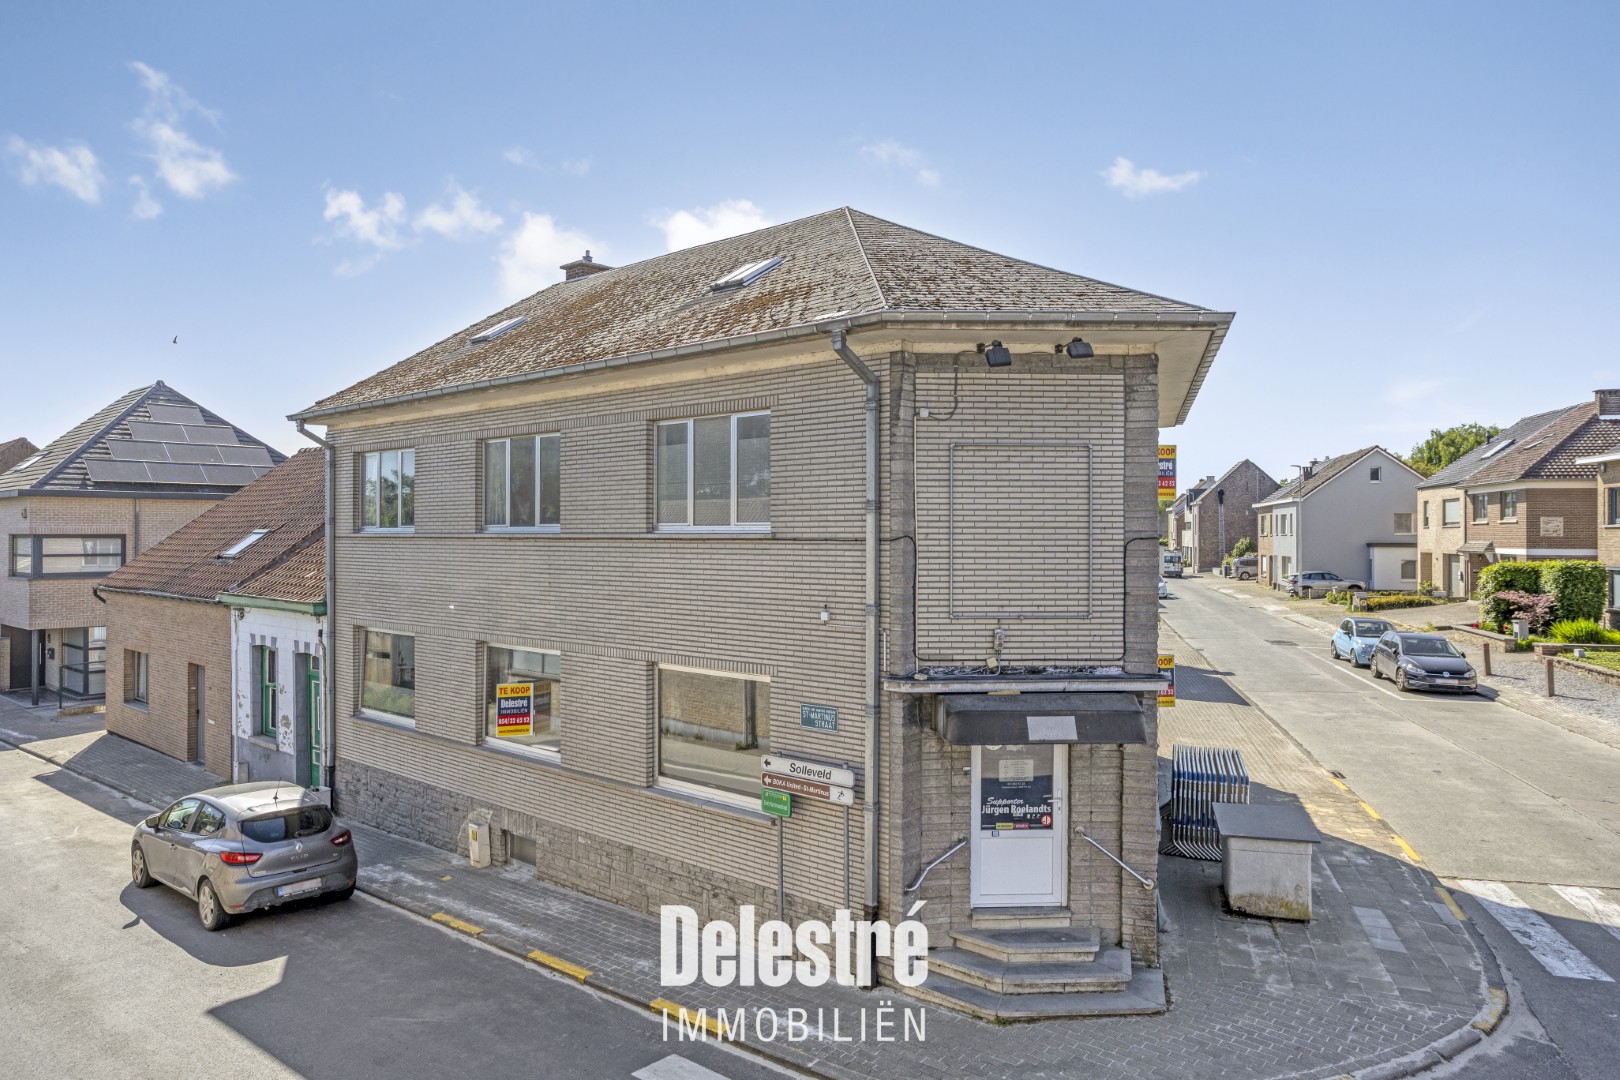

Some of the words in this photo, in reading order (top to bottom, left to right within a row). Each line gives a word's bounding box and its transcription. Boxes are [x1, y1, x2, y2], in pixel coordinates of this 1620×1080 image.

[1158, 658, 1173, 666] OOP
[499, 687, 508, 695] TE
[510, 686, 530, 695] KOOP
[500, 698, 528, 709] Delestré
[814, 719, 836, 730] STRAAT
[789, 762, 832, 781] Solleveld
[982, 805, 1009, 815] Jürgen
[1011, 804, 1051, 813] Roelandts
